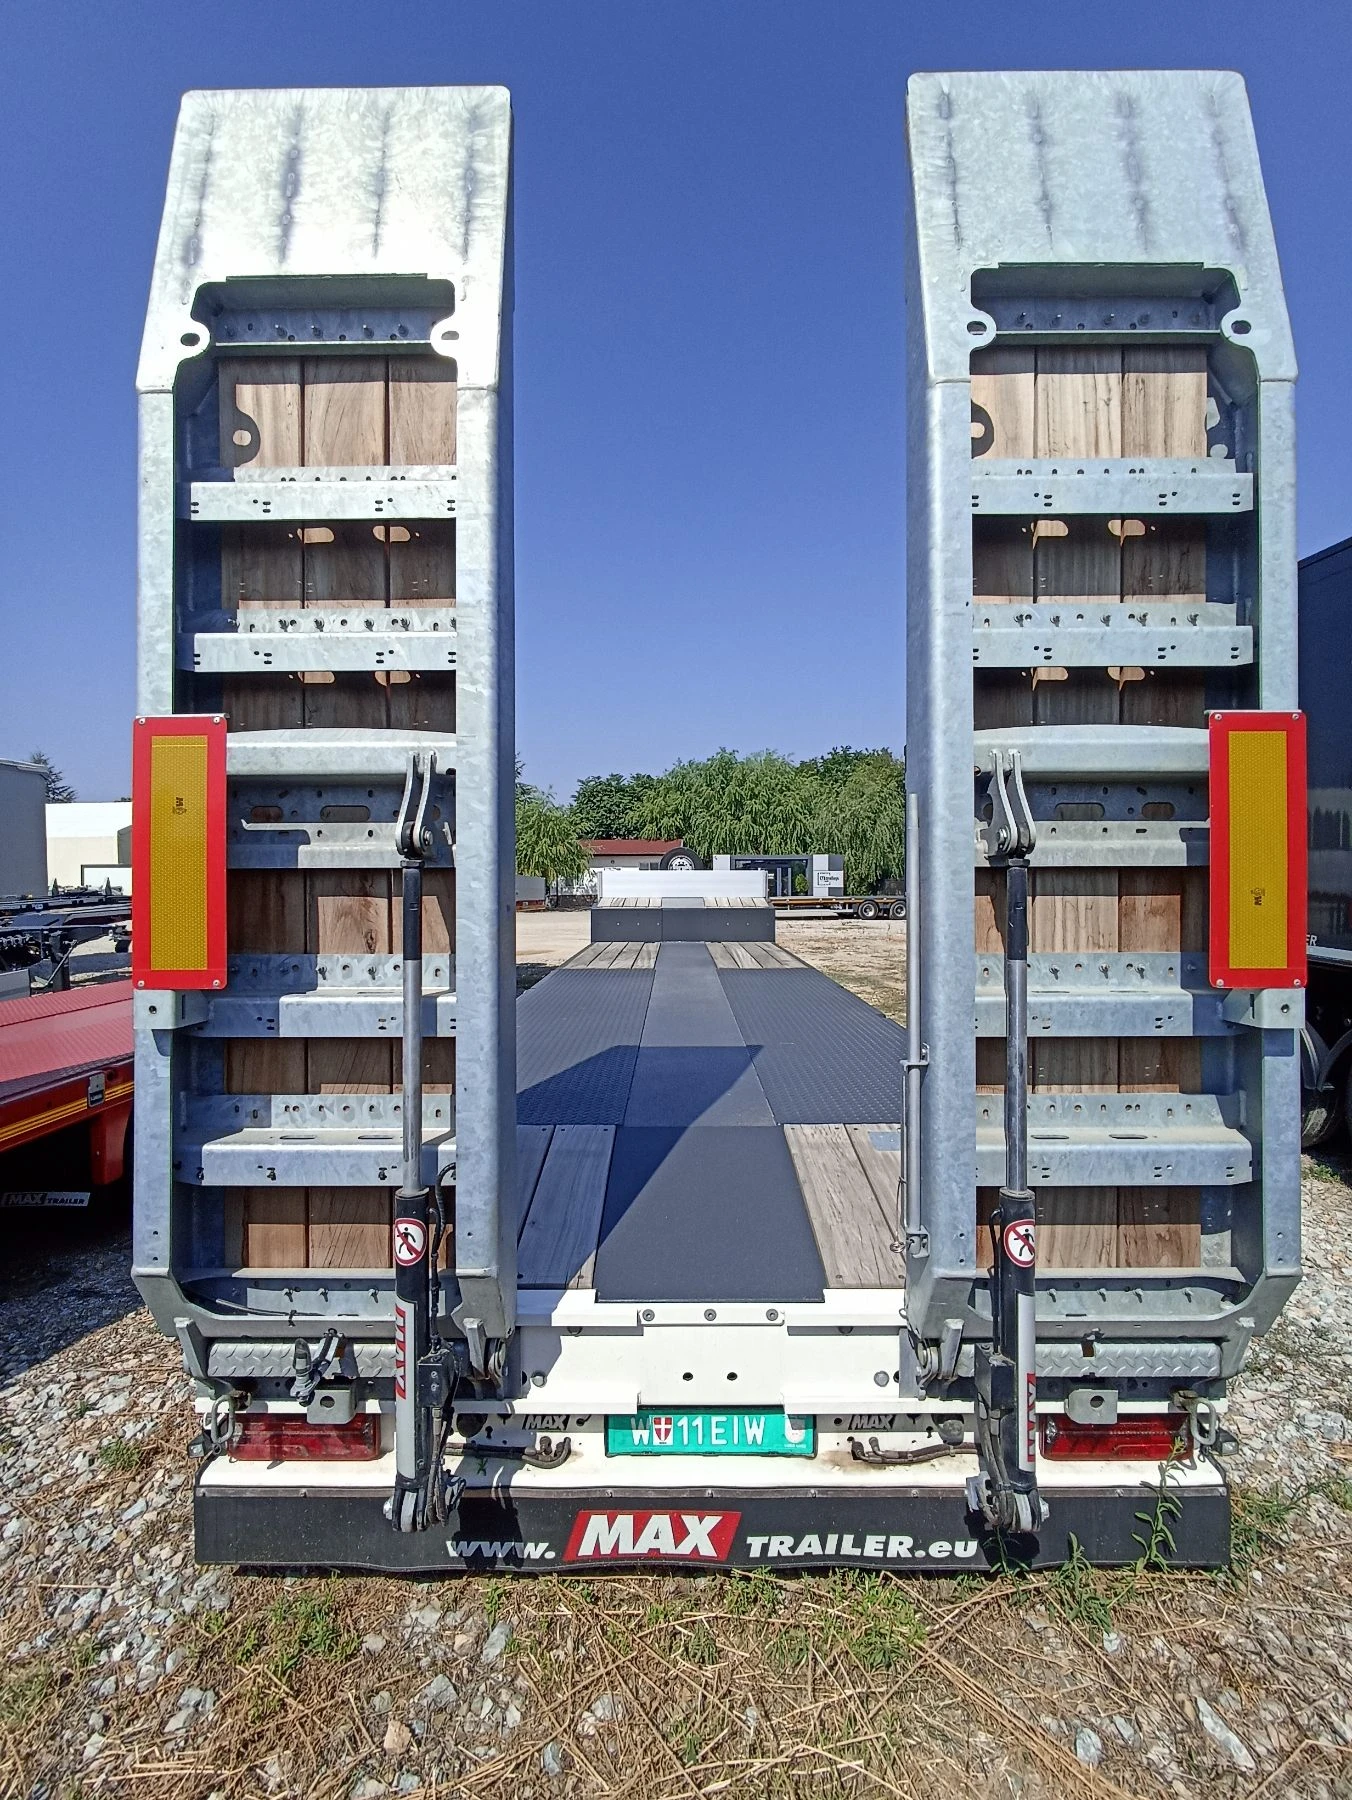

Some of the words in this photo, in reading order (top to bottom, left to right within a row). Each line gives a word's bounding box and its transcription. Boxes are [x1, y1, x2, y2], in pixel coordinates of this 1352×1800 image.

[524, 1414, 567, 1431] MAX
[630, 1417, 650, 1446] W
[676, 1416, 766, 1446] 11EIW
[850, 1414, 893, 1430] MAX
[446, 1541, 556, 1560] www.
[577, 1514, 723, 1558] MAX
[746, 1533, 978, 1558] TRAILER.eu
